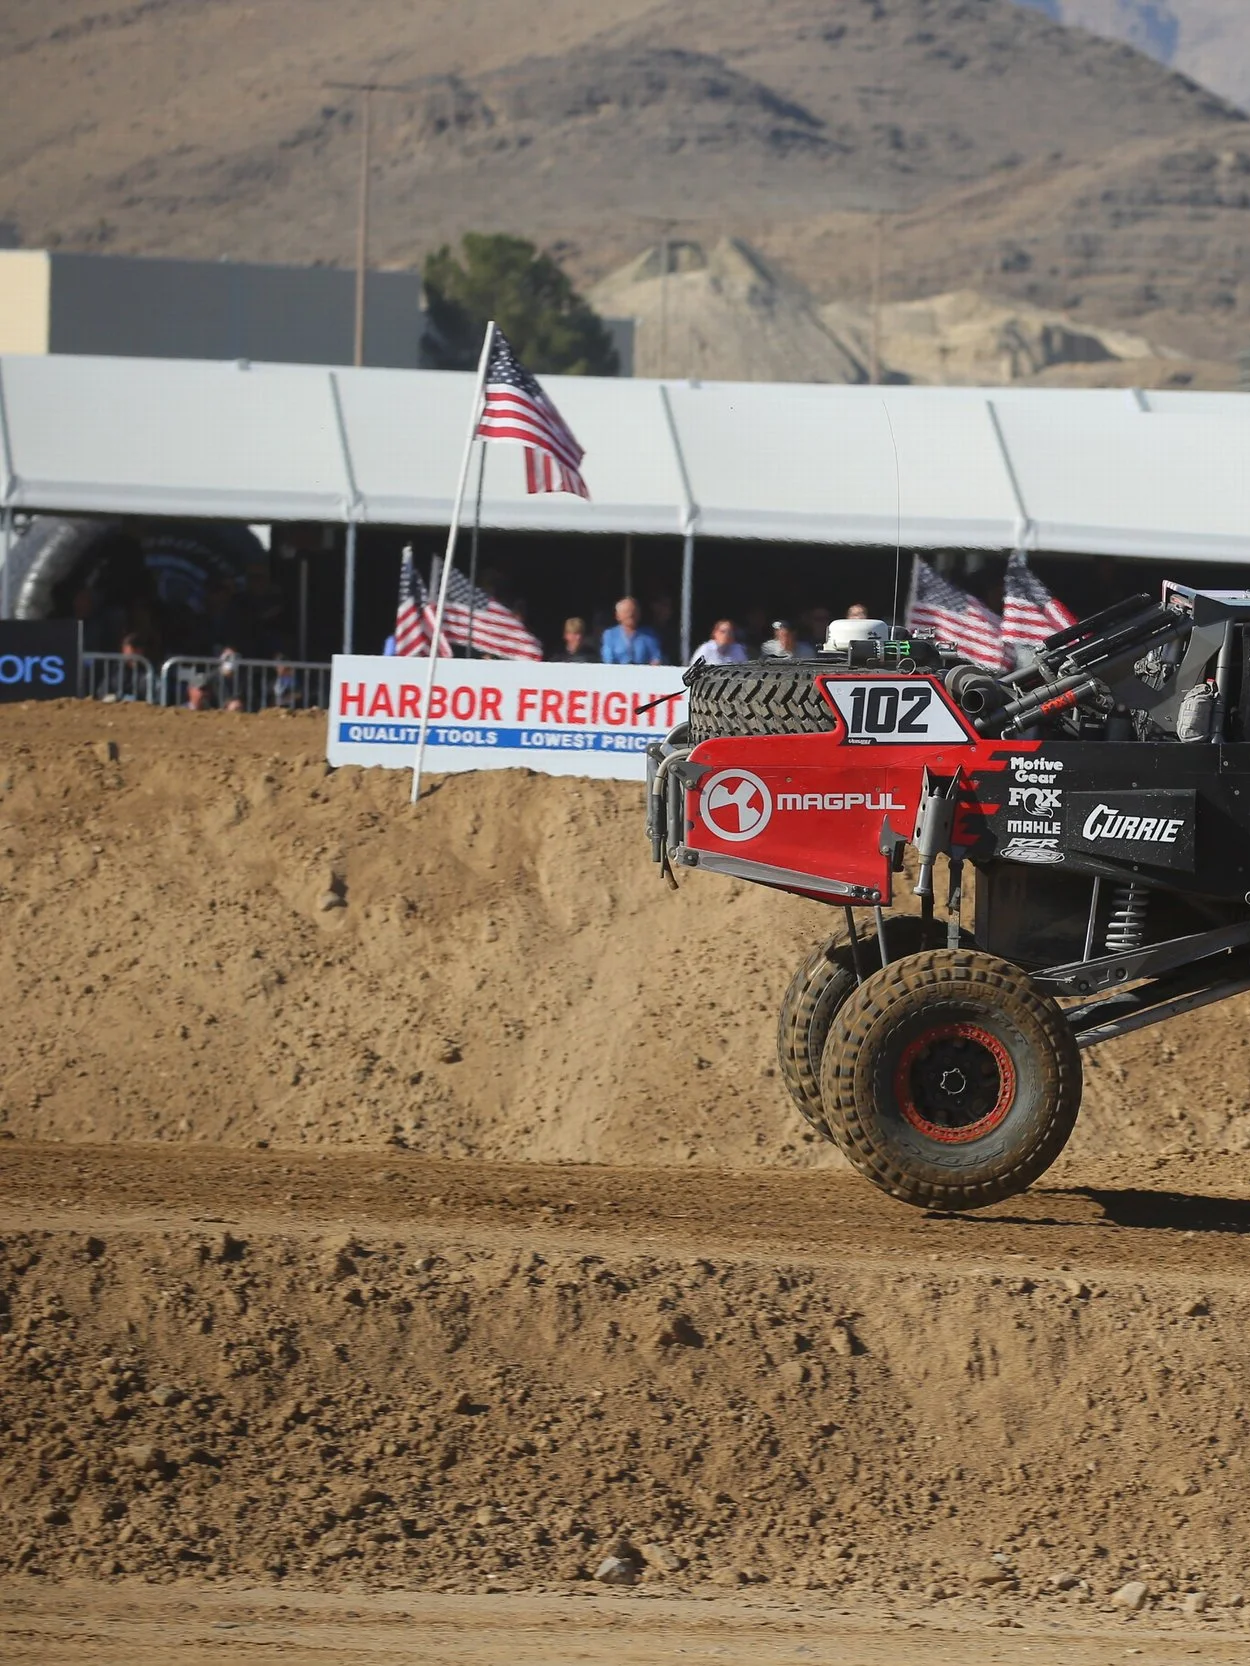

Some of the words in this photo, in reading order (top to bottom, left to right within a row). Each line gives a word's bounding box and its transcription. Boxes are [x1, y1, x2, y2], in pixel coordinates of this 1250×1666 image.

[340, 682, 503, 721] HARBOR
[517, 688, 683, 727] FREIGHT
[850, 687, 932, 734] 102
[436, 728, 499, 745] TOOLS
[520, 731, 597, 748] LOWEST
[601, 734, 665, 750] PRIC
[1010, 757, 1063, 771] Motive
[1014, 770, 1057, 784] Gear
[777, 793, 906, 810] MAGPUL
[1008, 787, 1062, 813] FOX
[1007, 820, 1062, 835] MAHLE
[1082, 804, 1185, 843] CURRIE
[1007, 838, 1060, 849] RZR
